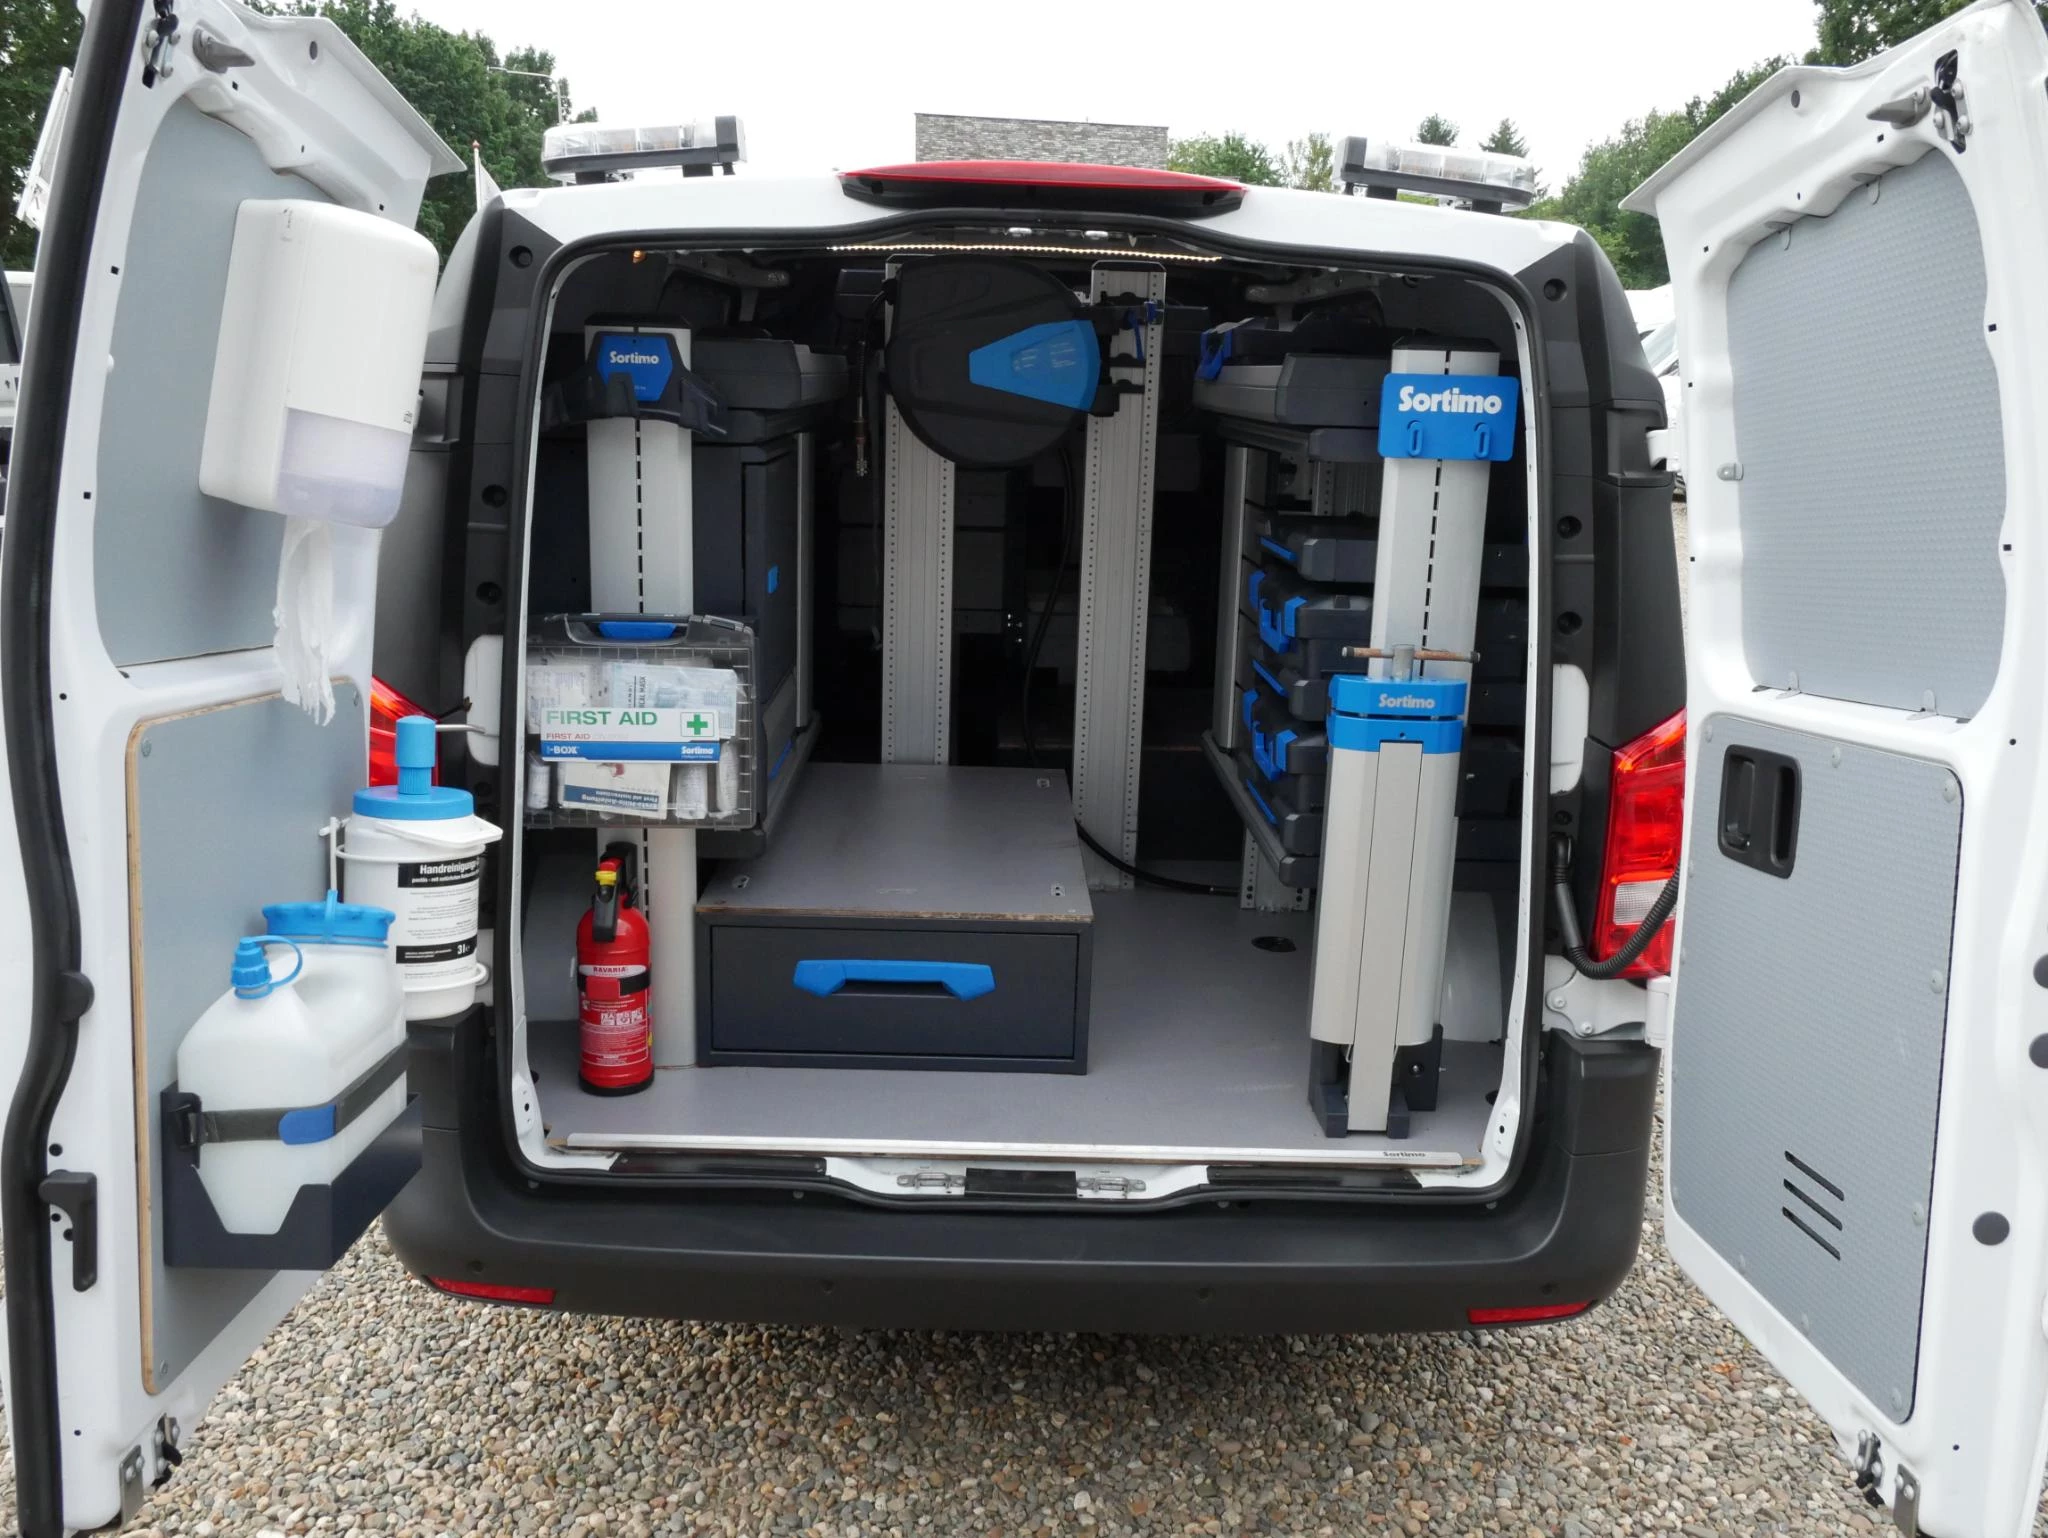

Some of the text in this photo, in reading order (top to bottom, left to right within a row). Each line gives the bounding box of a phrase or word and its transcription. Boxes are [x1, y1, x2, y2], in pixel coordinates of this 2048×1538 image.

[610, 351, 660, 365] Sortimo
[1398, 386, 1502, 414] Sortimo
[1378, 693, 1436, 709] Sortimo
[546, 711, 657, 726] FIRST AID
[681, 746, 714, 755] Sortimo
